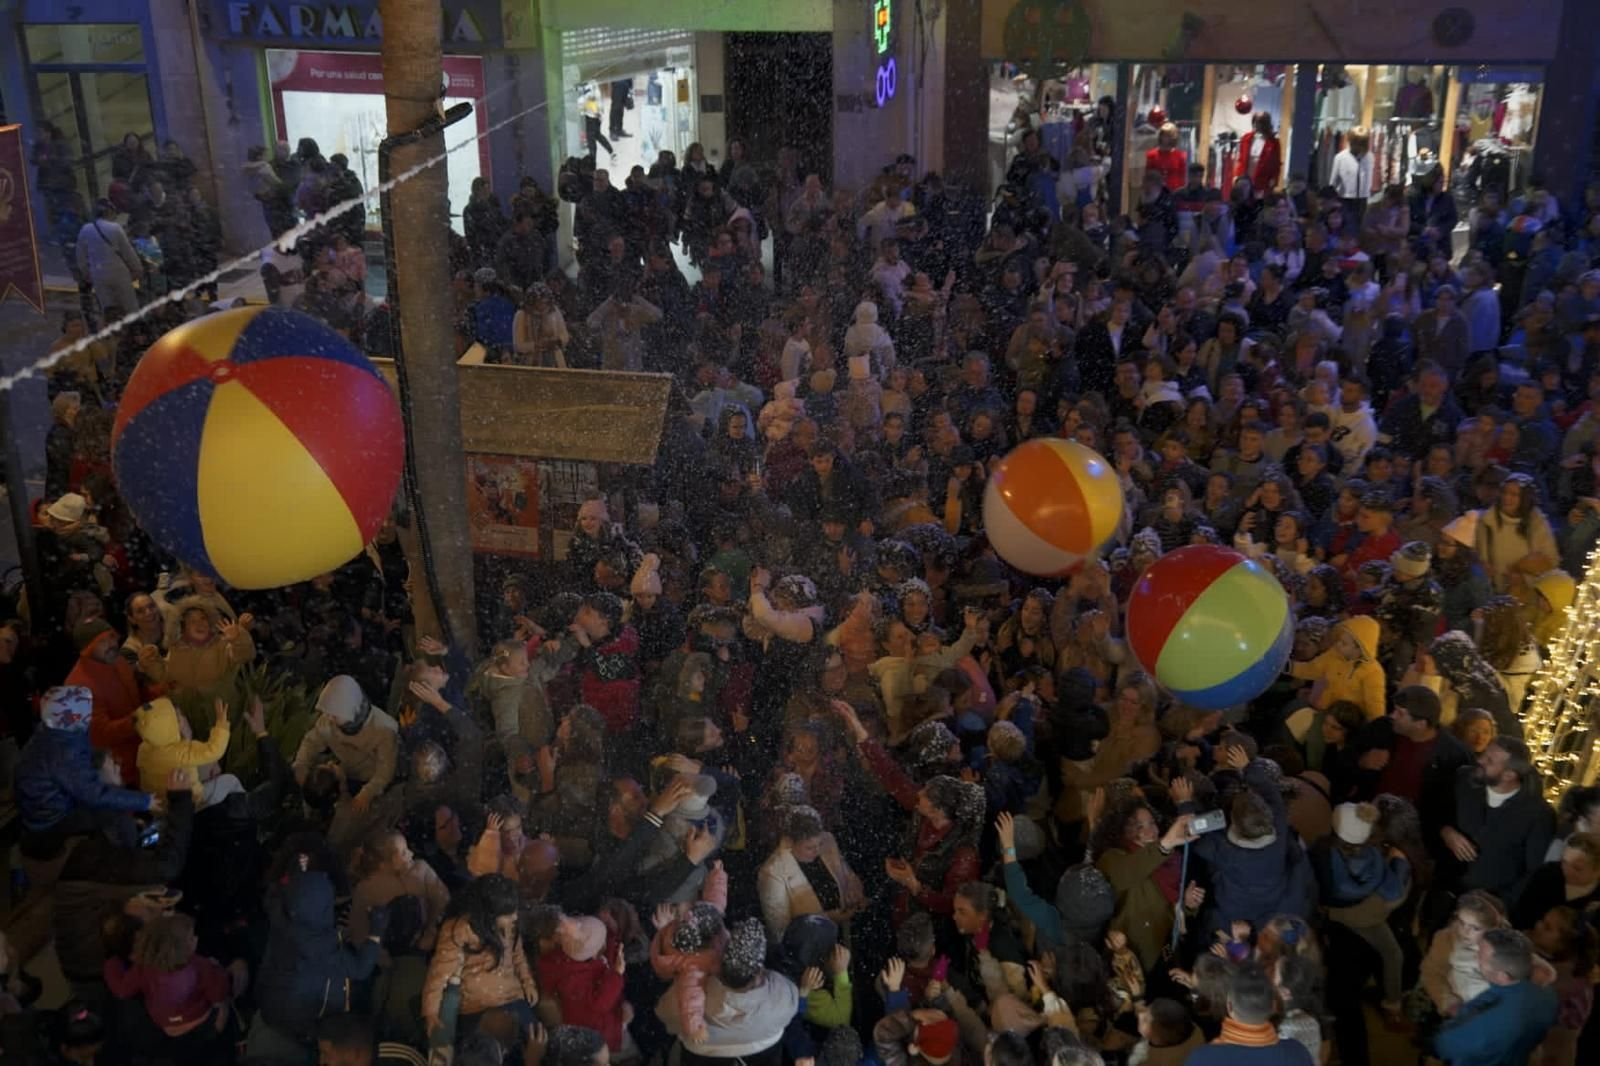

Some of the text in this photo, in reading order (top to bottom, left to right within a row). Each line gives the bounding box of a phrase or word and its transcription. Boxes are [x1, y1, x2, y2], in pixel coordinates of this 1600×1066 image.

[229, 2, 483, 41] FARMAA
[310, 68, 326, 78] Por
[326, 70, 342, 80] una
[344, 71, 366, 81] salud
